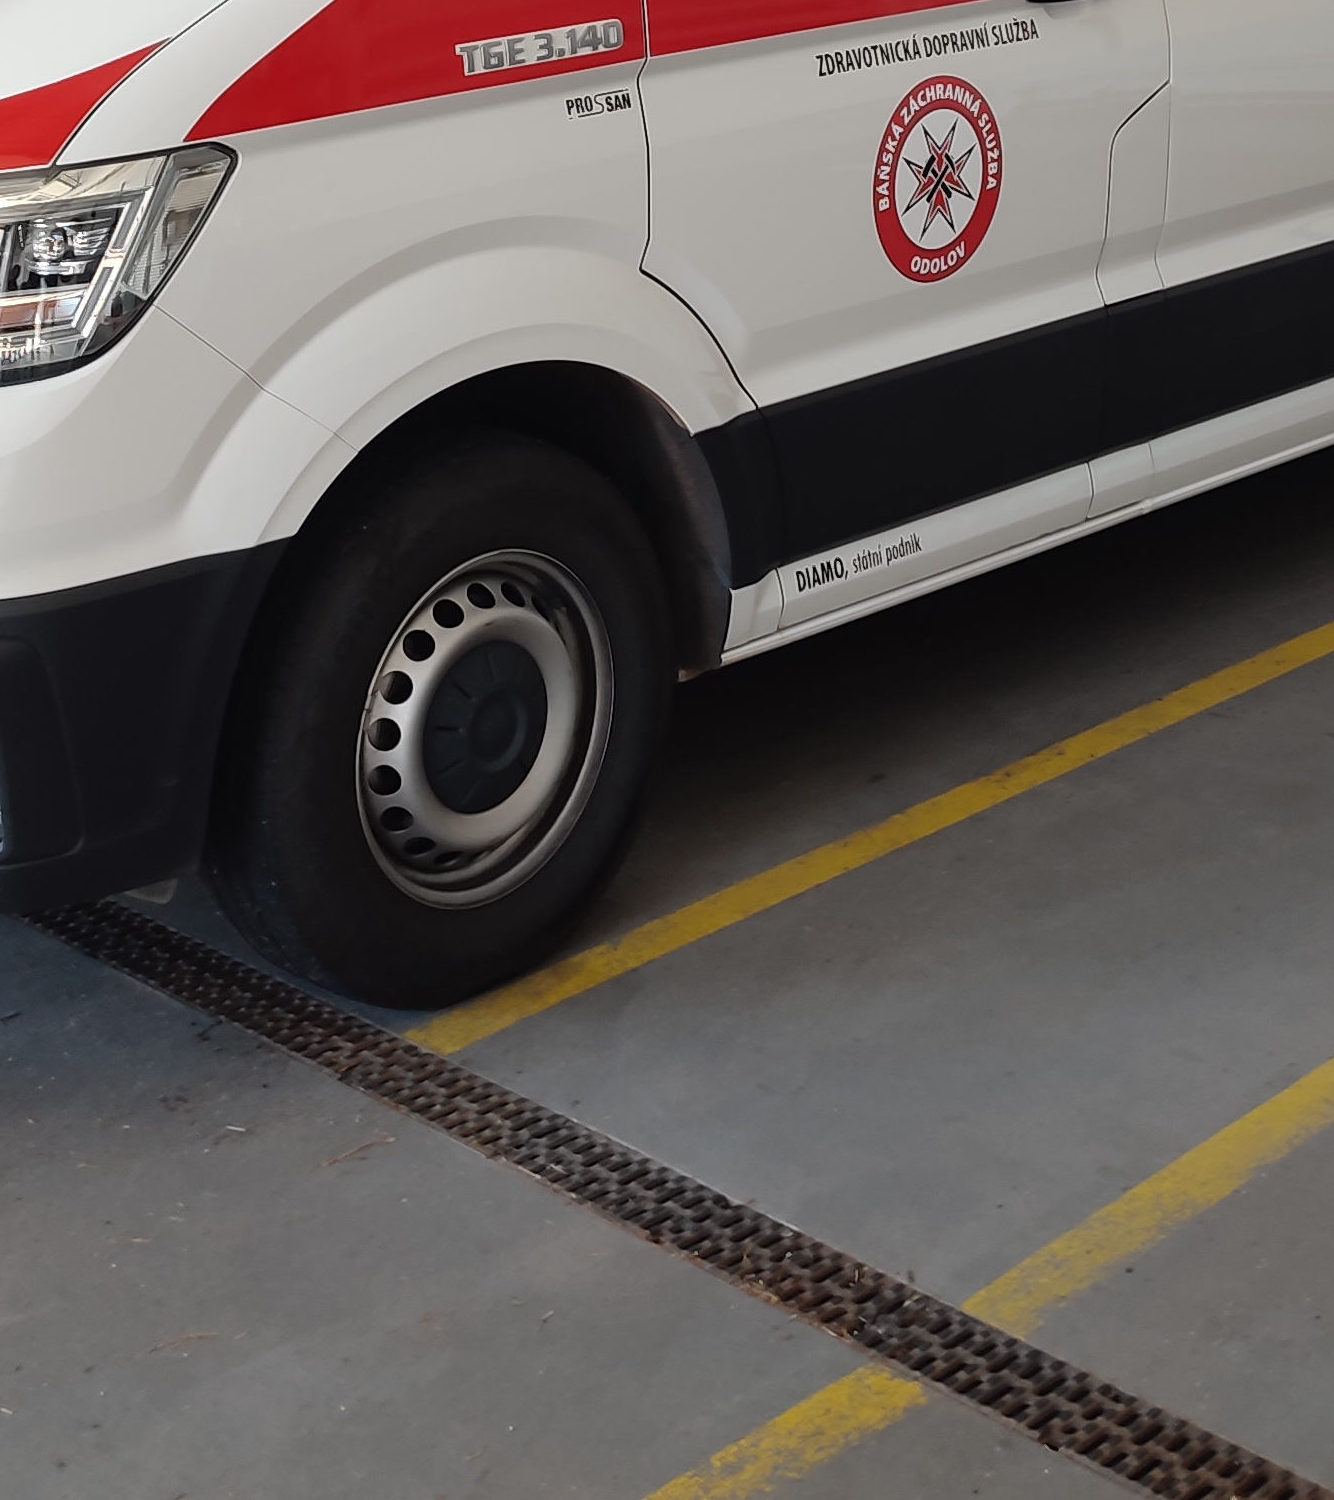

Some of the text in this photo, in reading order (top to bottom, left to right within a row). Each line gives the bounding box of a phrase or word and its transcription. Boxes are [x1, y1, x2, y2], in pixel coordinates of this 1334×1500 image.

[459, 20, 624, 74] TGE 3.140
[815, 17, 1040, 78] ZDRAVOTNICKÁ DOPRAVNÍ SLUŽBA
[876, 83, 1000, 212] BÁŇSKÁ ZÁCHRANNÁ SLUŽBA
[910, 240, 967, 275] ODOLOV
[795, 532, 923, 593] DIAMO, státní podnik
